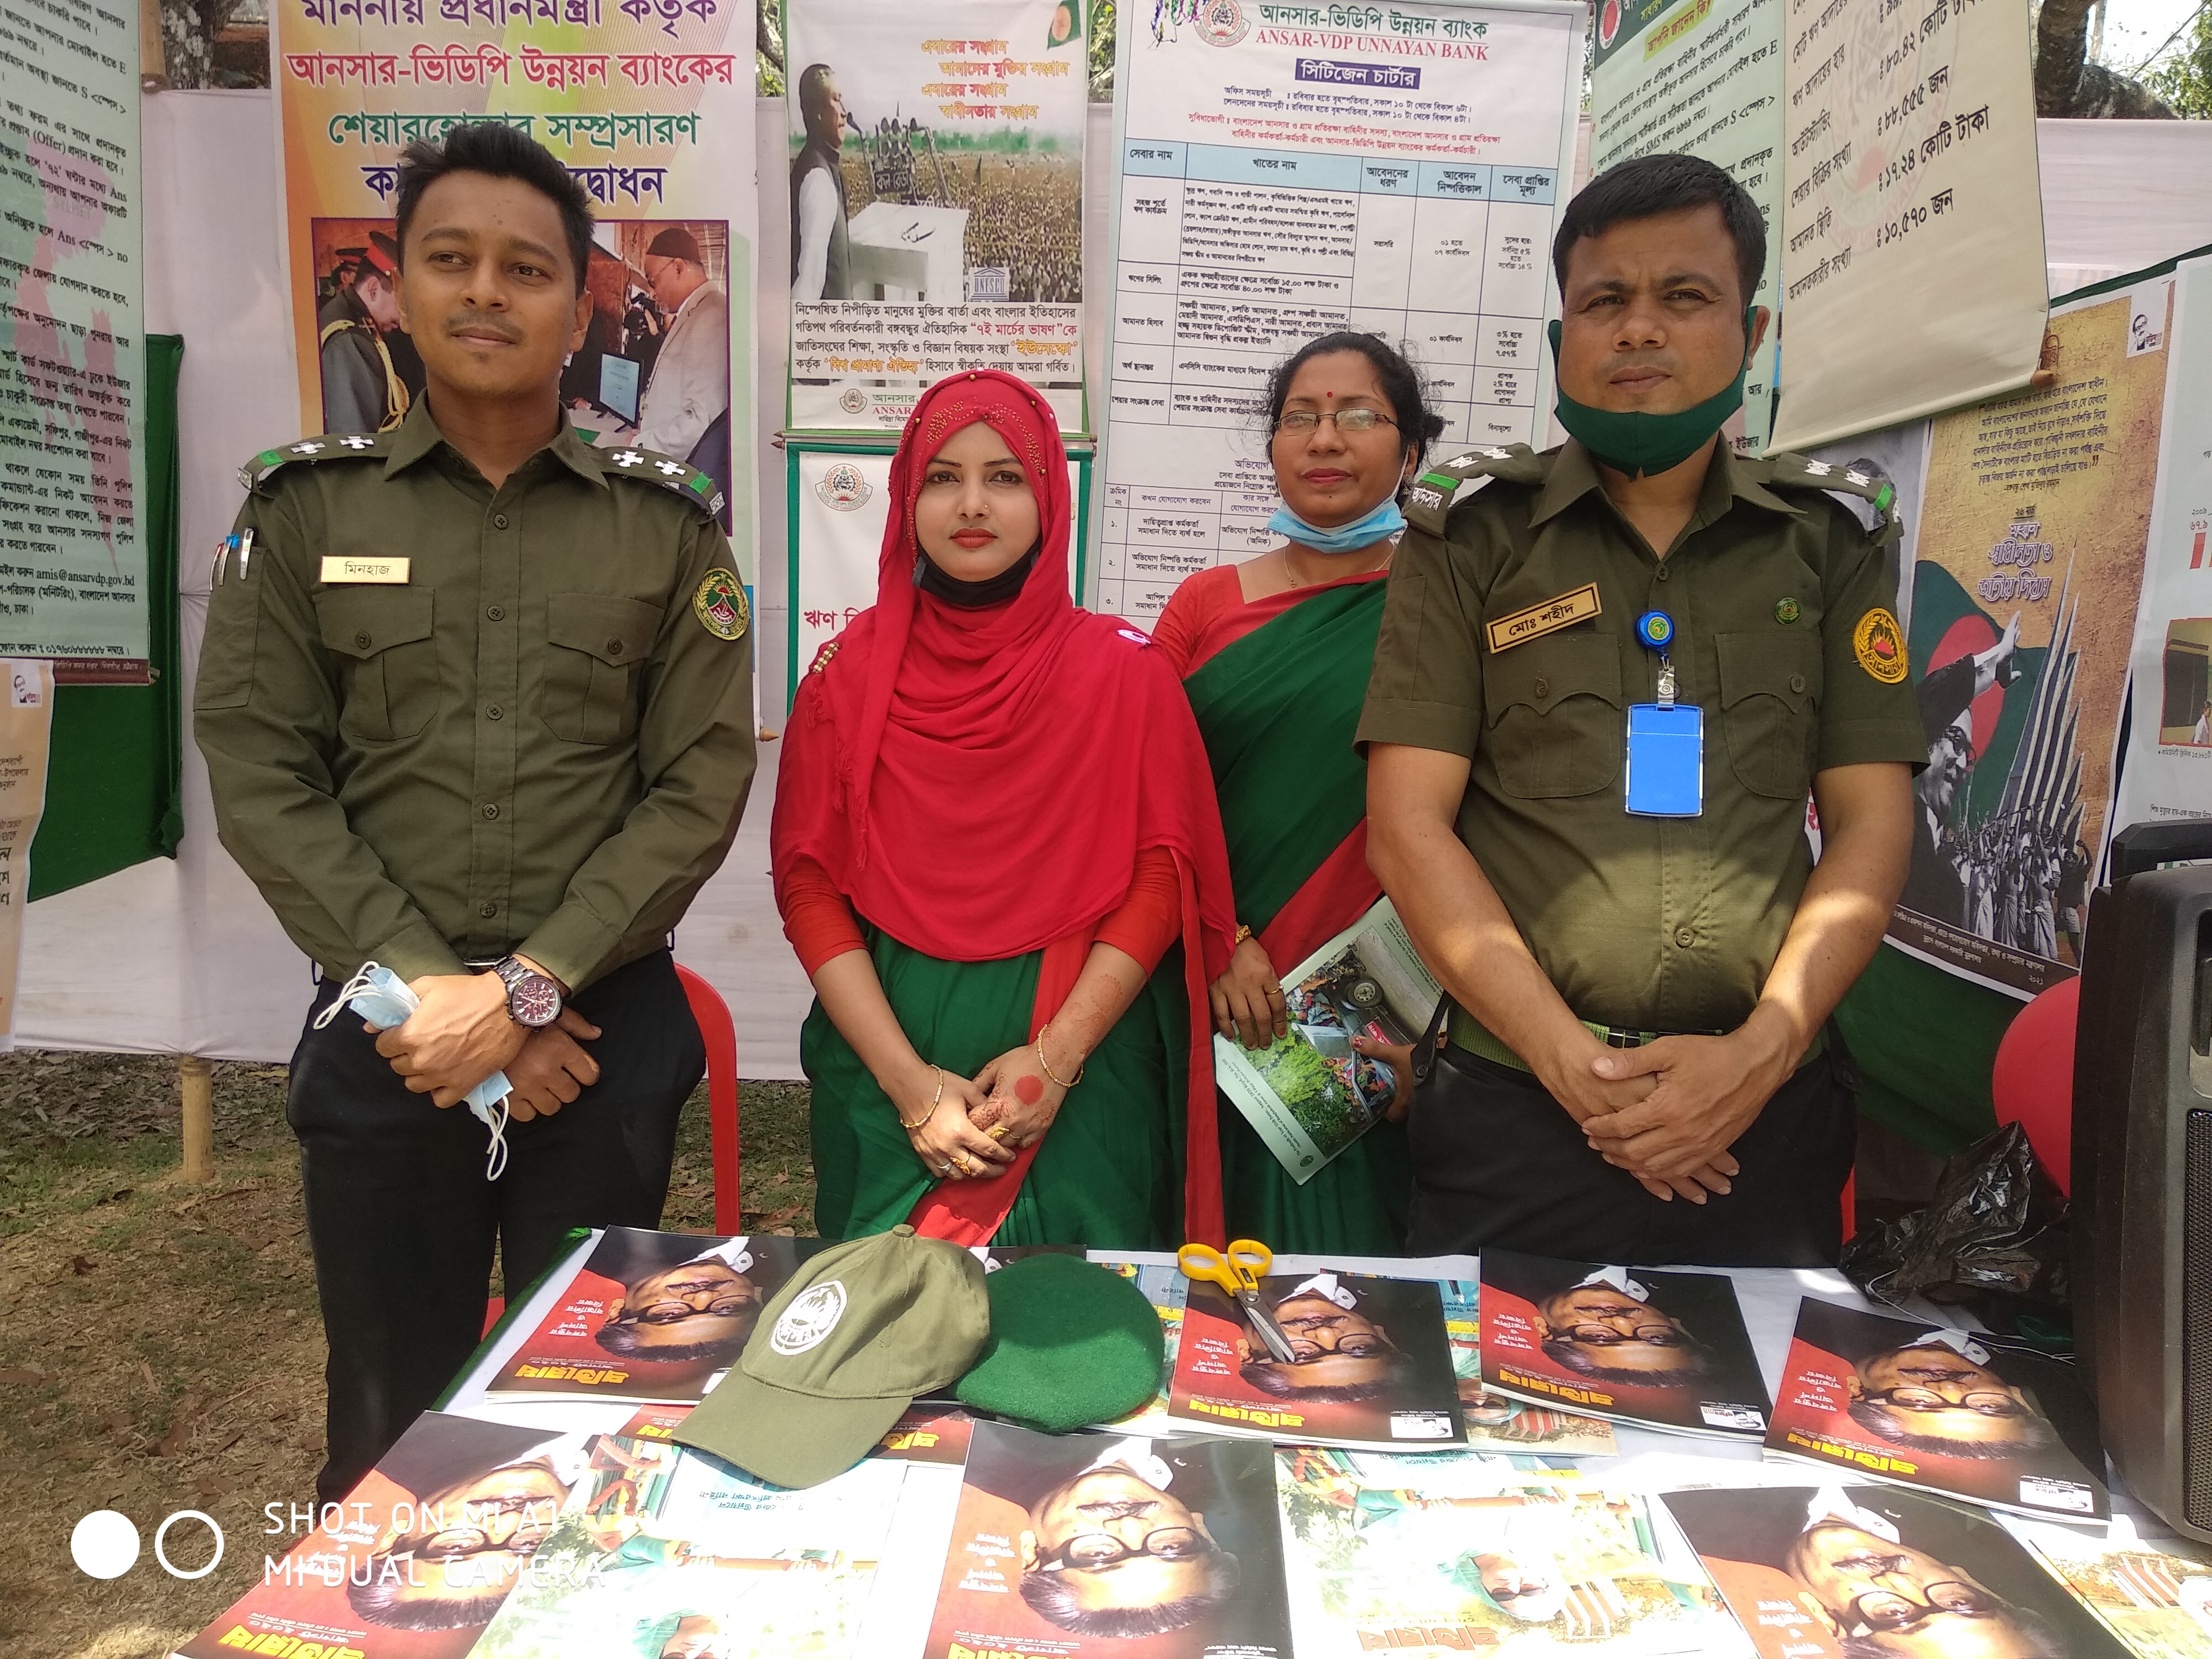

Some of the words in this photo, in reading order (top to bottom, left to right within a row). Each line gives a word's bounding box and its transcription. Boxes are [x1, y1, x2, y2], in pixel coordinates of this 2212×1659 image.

[1260, 4, 1384, 32] আনসার-ভিডিপি
[1389, 9, 1437, 38] উন্নয়ন
[1443, 19, 1489, 40] ব্যাংক
[1919, 1, 1948, 44] কোটি
[921, 39, 967, 54] এবারের
[970, 40, 1009, 55] সংগ্রাম
[1255, 29, 1353, 51] ANSAR-VDP
[1357, 37, 1437, 57] UNNAYAN
[1441, 44, 1489, 61] BANK
[1751, 46, 1767, 63] হতে
[1770, 39, 1778, 56] E
[1833, 44, 1845, 70] হার
[286, 44, 509, 86] আনসার-ভিডিপি
[519, 44, 610, 92] উন্নয়ন
[617, 51, 736, 87] ব্যাংকের
[939, 61, 990, 77] আমাদের
[994, 59, 1027, 79] মুক্তির
[1031, 61, 1070, 77] সংগ্রাম
[1301, 60, 1369, 84] সিটিজেন
[1373, 66, 1417, 87] চার্টার
[1928, 65, 1949, 95] জন
[921, 82, 967, 97] এবারের
[970, 83, 1008, 98] সংগ্রাম
[939, 101, 997, 120] স্বাধীনতার
[1000, 105, 1039, 120] সংগ্রাম
[1730, 109, 1736, 127] S
[544, 111, 702, 150] সম্প্রসারণ
[1921, 121, 1952, 164] কোটি
[1955, 104, 1990, 141] টাকা
[33, 130, 66, 154] (Offer)
[1130, 149, 1154, 159] সেবার
[1157, 151, 1173, 160] নাম
[1253, 158, 1279, 169] খাতের
[1281, 160, 1297, 171] নাম
[1367, 167, 1409, 178] আবেদনের
[1443, 171, 1477, 181] আবেদন
[1503, 175, 1522, 185] সেবা
[1791, 178, 1811, 209] শেয়ার
[1833, 141, 1852, 174] সংখ্যা
[110, 186, 127, 202] Ans
[1520, 185, 1536, 197] মূল্য
[1884, 206, 1927, 245] ১০,৫৭০
[1931, 188, 1953, 215] জন
[58, 231, 76, 245] Ans
[1790, 225, 1815, 254] আমানত
[117, 252, 128, 263] no
[1832, 245, 1851, 275] সংখ্যা
[795, 302, 838, 315] নিষ্পেষিত
[842, 302, 880, 317] নিপীড়িত
[884, 306, 915, 319] মানুষের
[917, 303, 944, 319] মুক্তির
[947, 304, 969, 318] বার্তা
[972, 307, 992, 318] এবং
[994, 306, 1026, 318] বাংলার
[1029, 305, 1076, 319] ইতিহাসের
[796, 320, 826, 333] গতিপথ
[830, 320, 884, 334] পরিবর্তনকারী
[886, 324, 919, 336] বঙ্গবন্ধুর
[922, 320, 968, 336] ঐতিহাসিক
[995, 321, 1025, 336] মার্চের
[1147, 317, 1164, 327] হিসাব
[796, 338, 846, 353] জাতিসংঘের
[878, 340, 909, 357] সংস্কৃতি
[912, 343, 920, 352] ও
[923, 340, 952, 354] বিজ্ঞান
[954, 341, 985, 355] বিষয়ক
[987, 344, 1010, 356] সংস্থা
[796, 356, 821, 373] কর্তৃক
[851, 359, 884, 373] প্রামাণ্য
[925, 357, 954, 373] হিসাবে
[1017, 362, 1044, 373] আমরা
[1235, 458, 1270, 470] অভিযোগ
[1159, 495, 1187, 505] যোগাযোগ
[1138, 528, 1160, 536] সমাধান
[1176, 519, 1199, 528] কর্মকর্তা
[36, 568, 135, 587] amis@ansarvdp.gov.bd
[345, 561, 390, 576] মিনহাজ
[79, 589, 109, 601] বাংলাদেশ
[111, 591, 135, 603] আনসার
[804, 609, 838, 631] ঋণ
[1540, 603, 1574, 623] শহীদ
